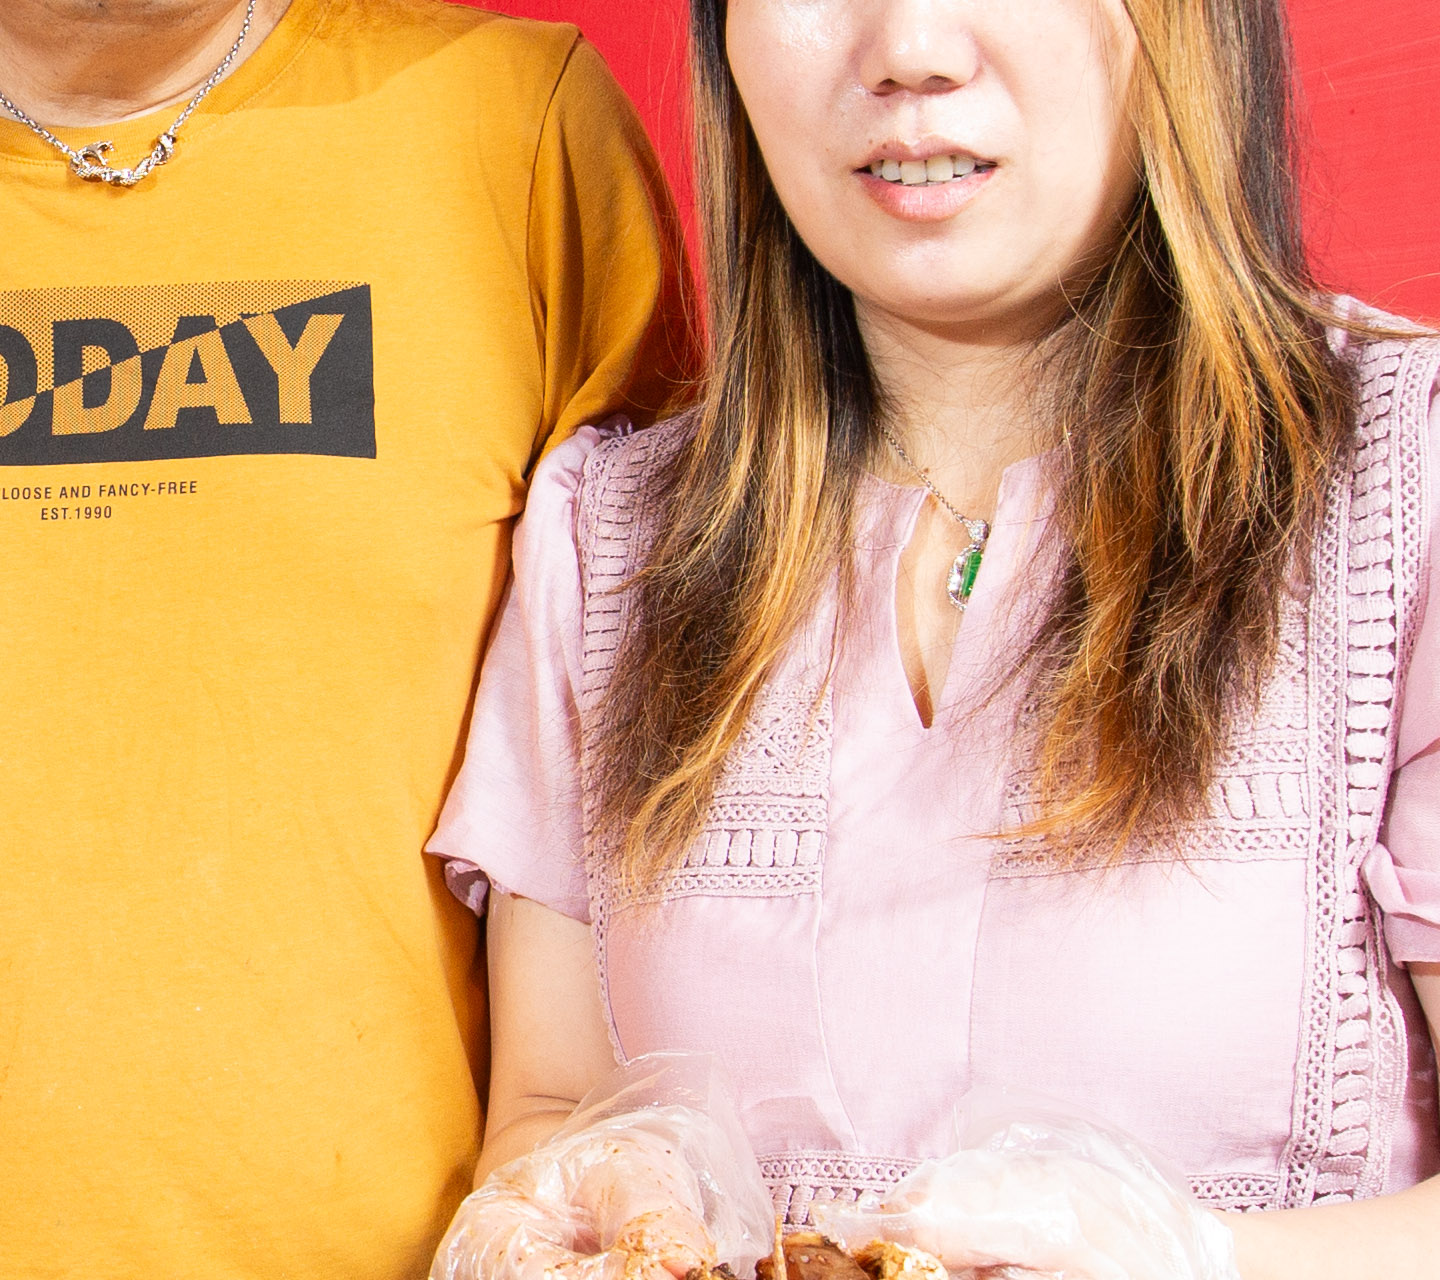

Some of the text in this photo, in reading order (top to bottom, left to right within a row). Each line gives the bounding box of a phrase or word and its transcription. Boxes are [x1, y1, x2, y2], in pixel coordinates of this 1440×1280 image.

[58, 484, 93, 499] AND
[98, 480, 199, 498] FANCY-FREE
[40, 504, 113, 521] EST.1990
